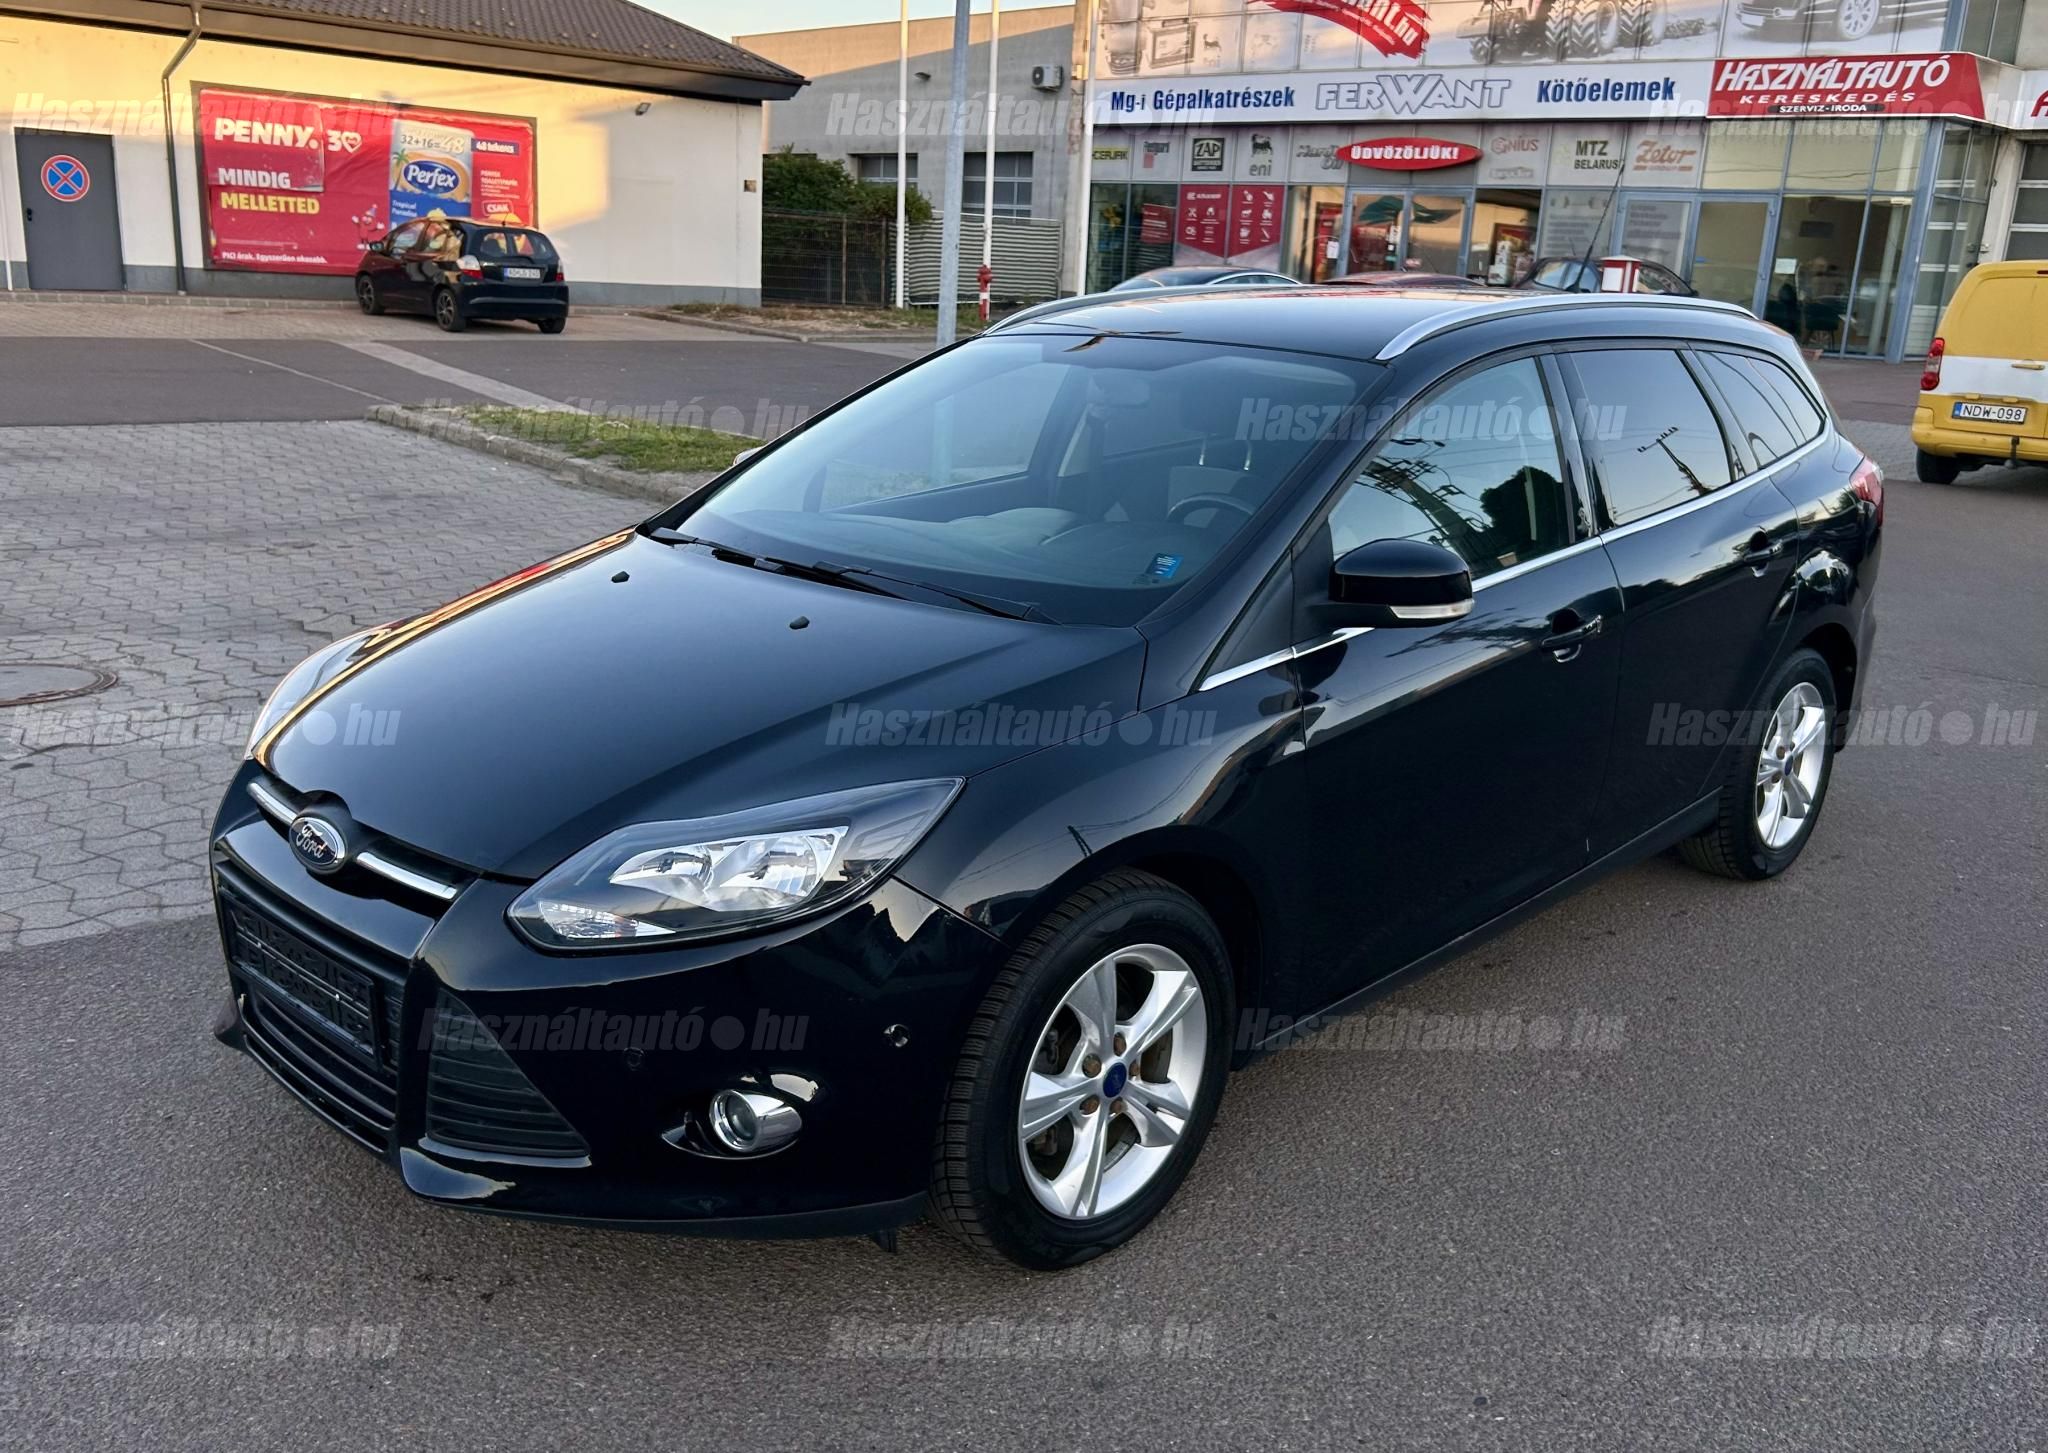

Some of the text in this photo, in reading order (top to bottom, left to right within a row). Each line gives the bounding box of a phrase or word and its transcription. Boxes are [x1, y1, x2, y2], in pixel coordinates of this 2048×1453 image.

[1715, 55, 1951, 91] HASZNÁLTAUTÓ
[1153, 85, 1296, 111] Gépalkatrészek
[1315, 74, 1511, 114] FERWANT
[1536, 77, 1676, 103] Kötőelemek
[1739, 91, 1916, 105] KERESKEDÉS
[1779, 104, 1867, 114] SZERVIZ-IRODA
[1197, 144, 1222, 157] ZAP
[1350, 145, 1459, 161] ÜDVÖZÖLJÜK!
[1575, 140, 1608, 156] MTZ
[1250, 159, 1272, 176] eni
[1574, 158, 1619, 170] BELARUS
[218, 167, 291, 189] MINDIG
[406, 164, 457, 191] Perfex
[220, 191, 320, 214] MELLETTED
[1962, 404, 2023, 421] NDW-098
[295, 823, 329, 859] Ford
